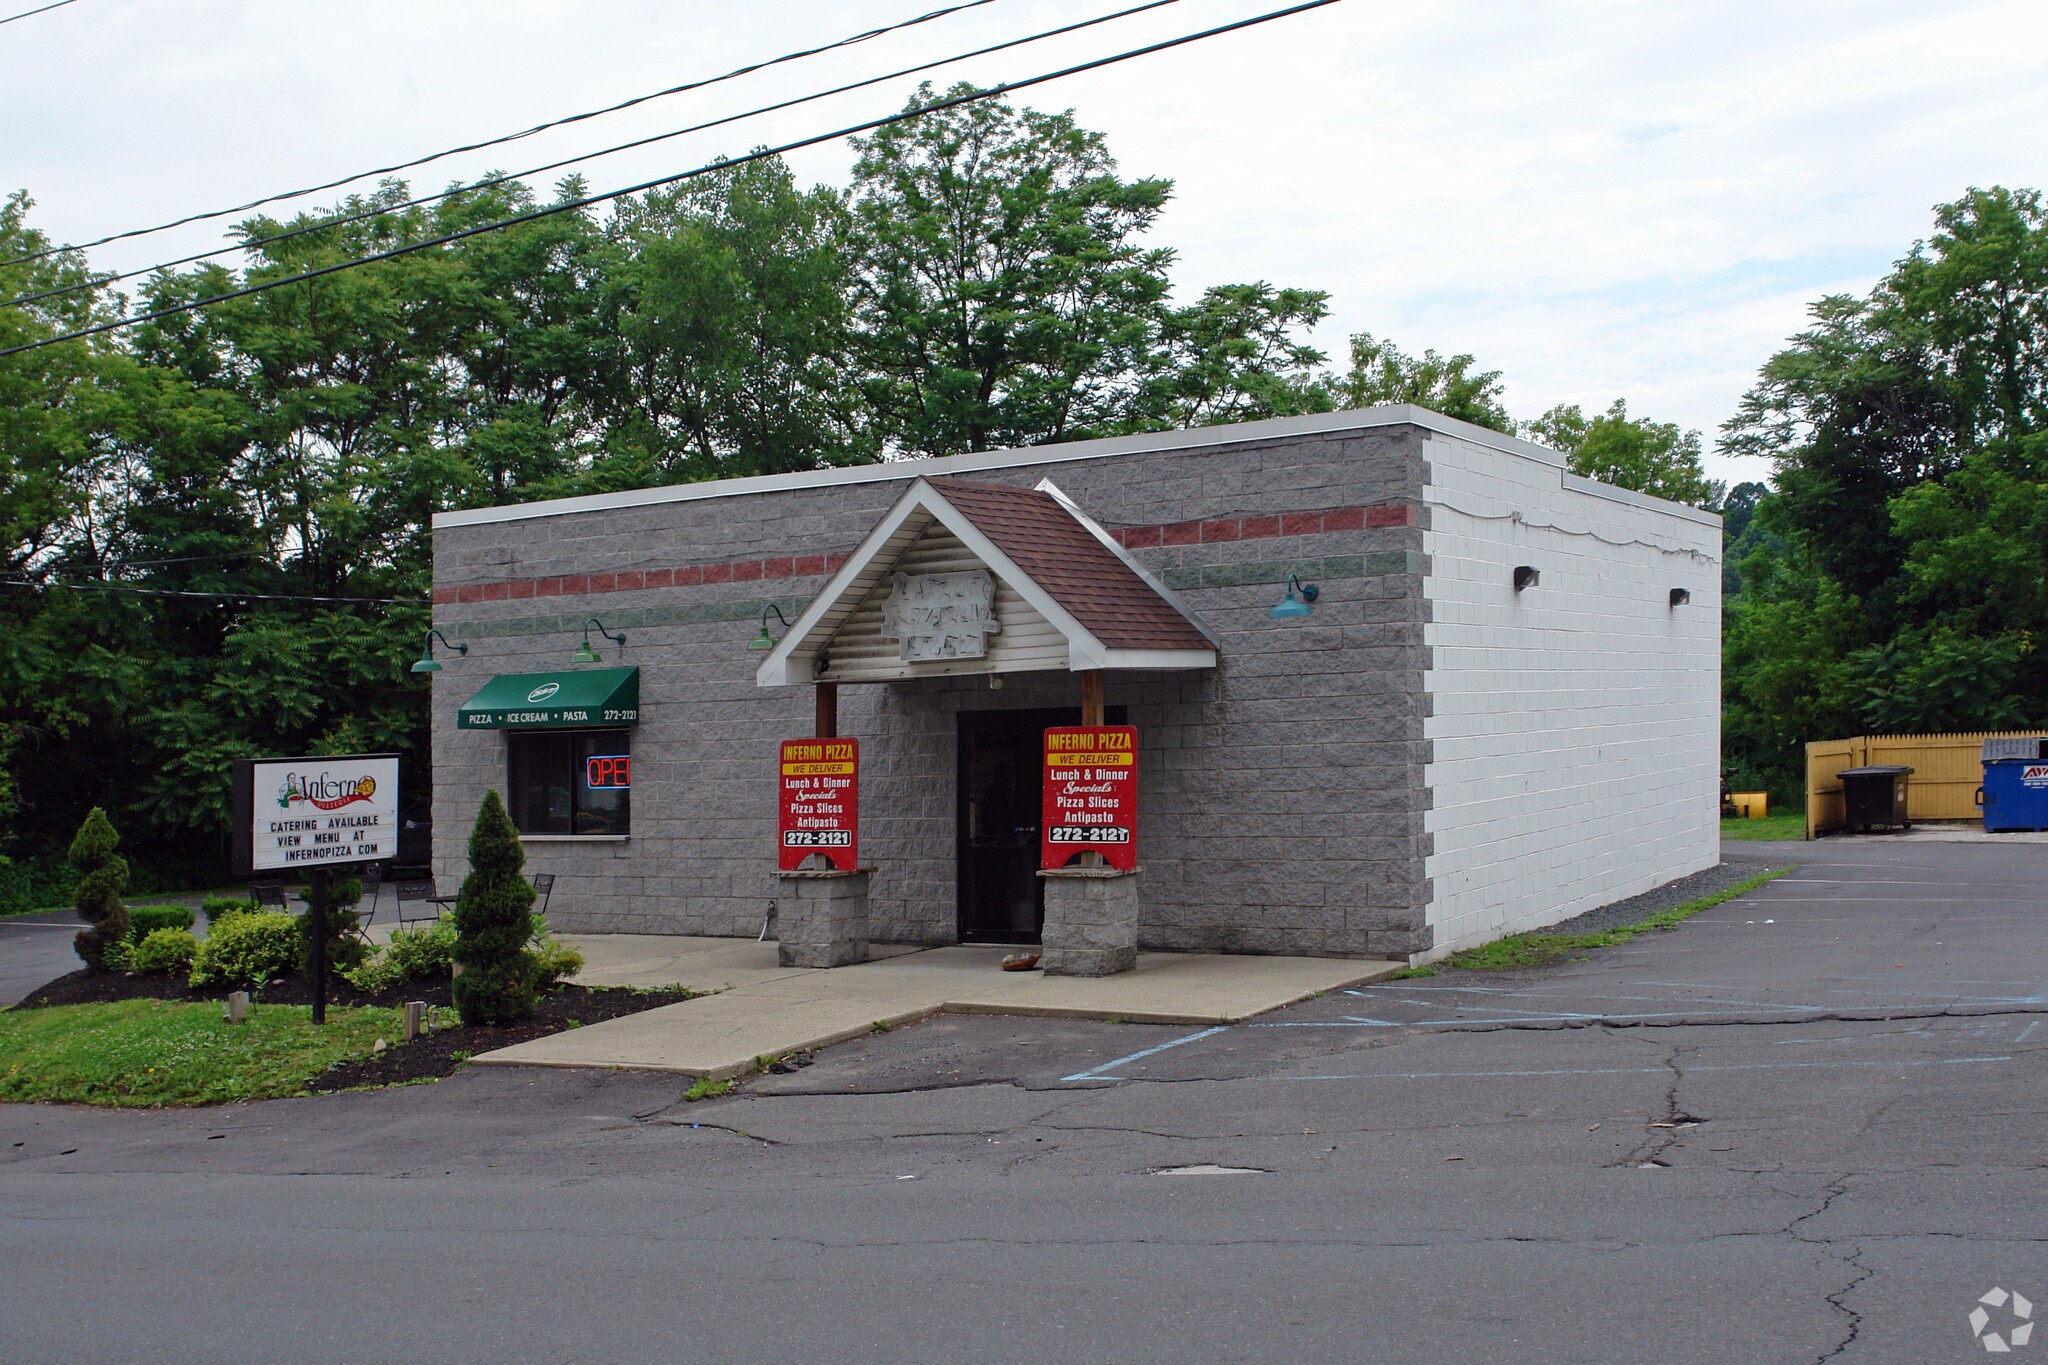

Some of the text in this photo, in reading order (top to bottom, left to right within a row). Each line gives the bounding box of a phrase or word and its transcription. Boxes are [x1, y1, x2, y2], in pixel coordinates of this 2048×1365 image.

[469, 711, 588, 724] PIZZA ICE CREAM PASTA
[604, 710, 637, 720] 272-2121
[1048, 733, 1131, 750] INFERNO PIZZA
[784, 744, 853, 760] INFERNO PIZZA
[1060, 754, 1120, 764] WE DELIVER
[793, 764, 843, 773] WE DELIVER
[1051, 769, 1128, 780] Lunch & Dinner
[786, 777, 850, 789] Lunch & Dinner
[1063, 781, 1113, 794] Specials
[796, 789, 837, 801] Specials
[791, 803, 843, 813] Pizza Slices
[1057, 796, 1119, 808] Pizza Slices
[797, 817, 838, 828] Antipasto
[1065, 811, 1113, 824] Antipasto
[271, 816, 378, 832] CATERING AVAILABLE
[278, 831, 365, 847] VIEW MENU AT
[787, 832, 848, 844] 272-2121
[1053, 828, 1127, 841] 272-2121
[286, 844, 377, 861] INFERNOPIZZA COM
